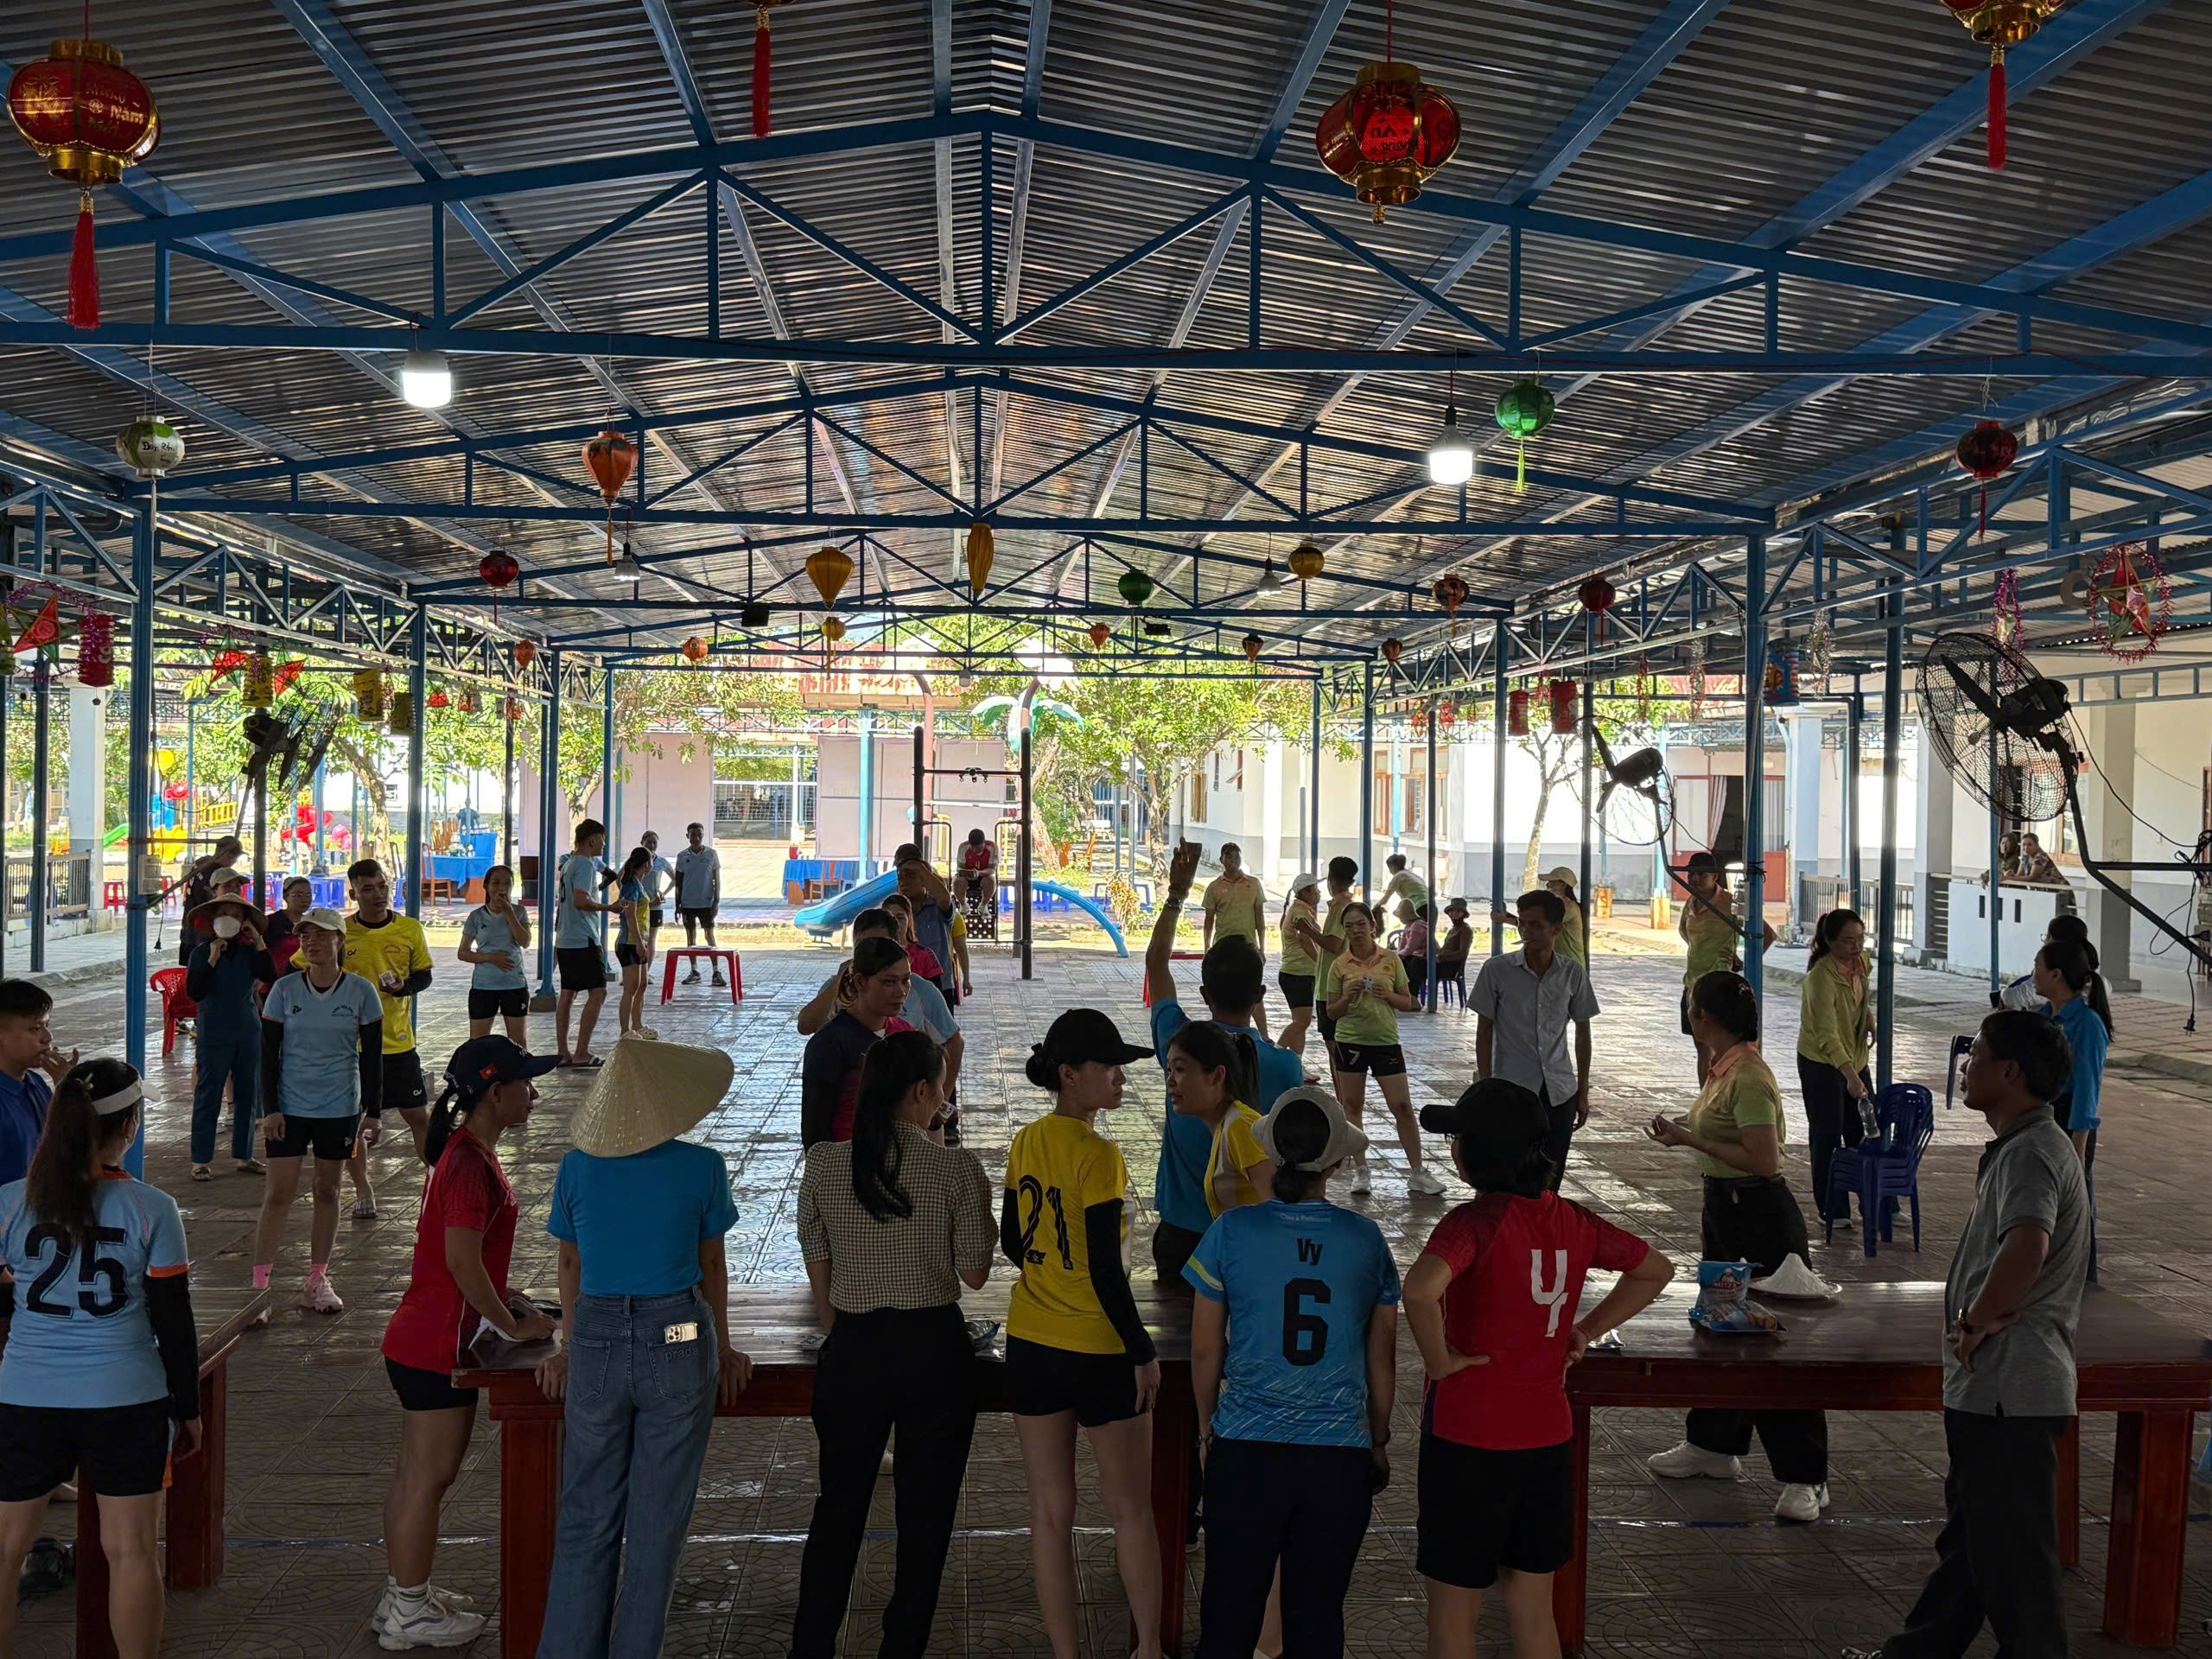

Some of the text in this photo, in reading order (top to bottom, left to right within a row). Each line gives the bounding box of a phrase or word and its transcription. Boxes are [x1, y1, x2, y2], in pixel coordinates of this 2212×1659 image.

[1348, 1049, 1361, 1065] 7
[1019, 1175, 1074, 1270] 21
[1297, 1237, 1323, 1266] Vy
[24, 1223, 131, 1319] 25
[1530, 1249, 1569, 1338] 4
[664, 1348, 699, 1363] prada
[1283, 1278, 1332, 1366] 6
